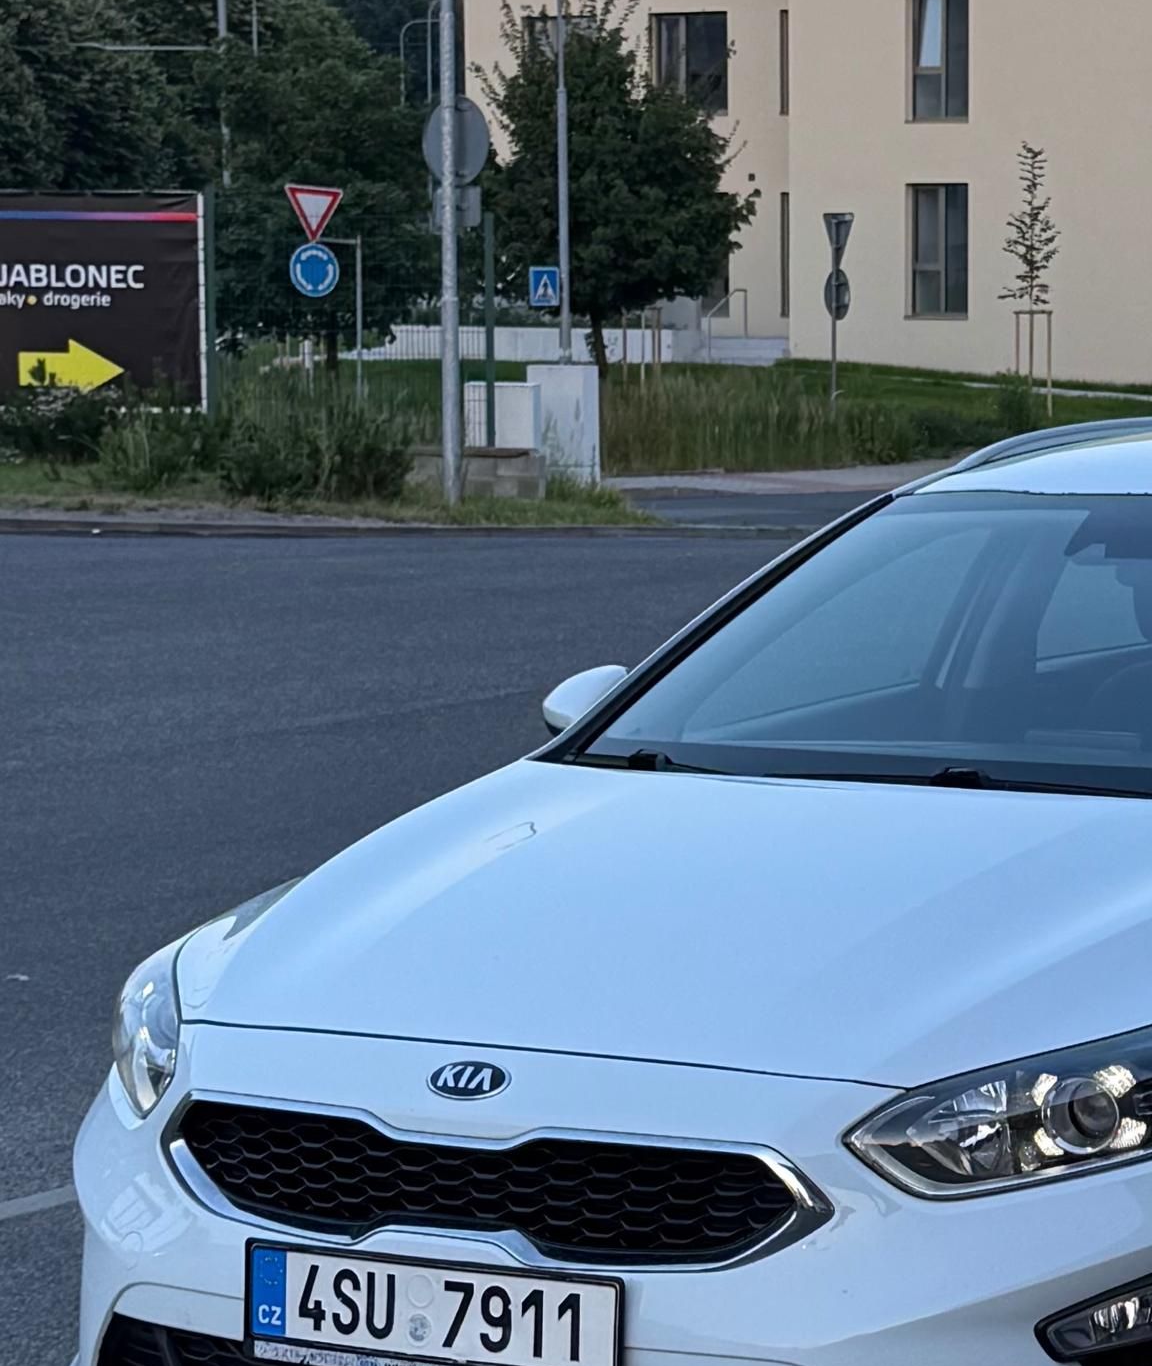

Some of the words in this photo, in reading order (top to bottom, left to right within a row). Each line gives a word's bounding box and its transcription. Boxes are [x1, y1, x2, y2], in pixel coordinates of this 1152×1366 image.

[0, 264, 144, 289] JABLONEC
[43, 291, 112, 310] drogerie
[437, 1065, 493, 1091] KIA
[258, 1304, 282, 1325] CZ
[299, 1264, 396, 1340] 4SU
[442, 1280, 581, 1363] 7911
